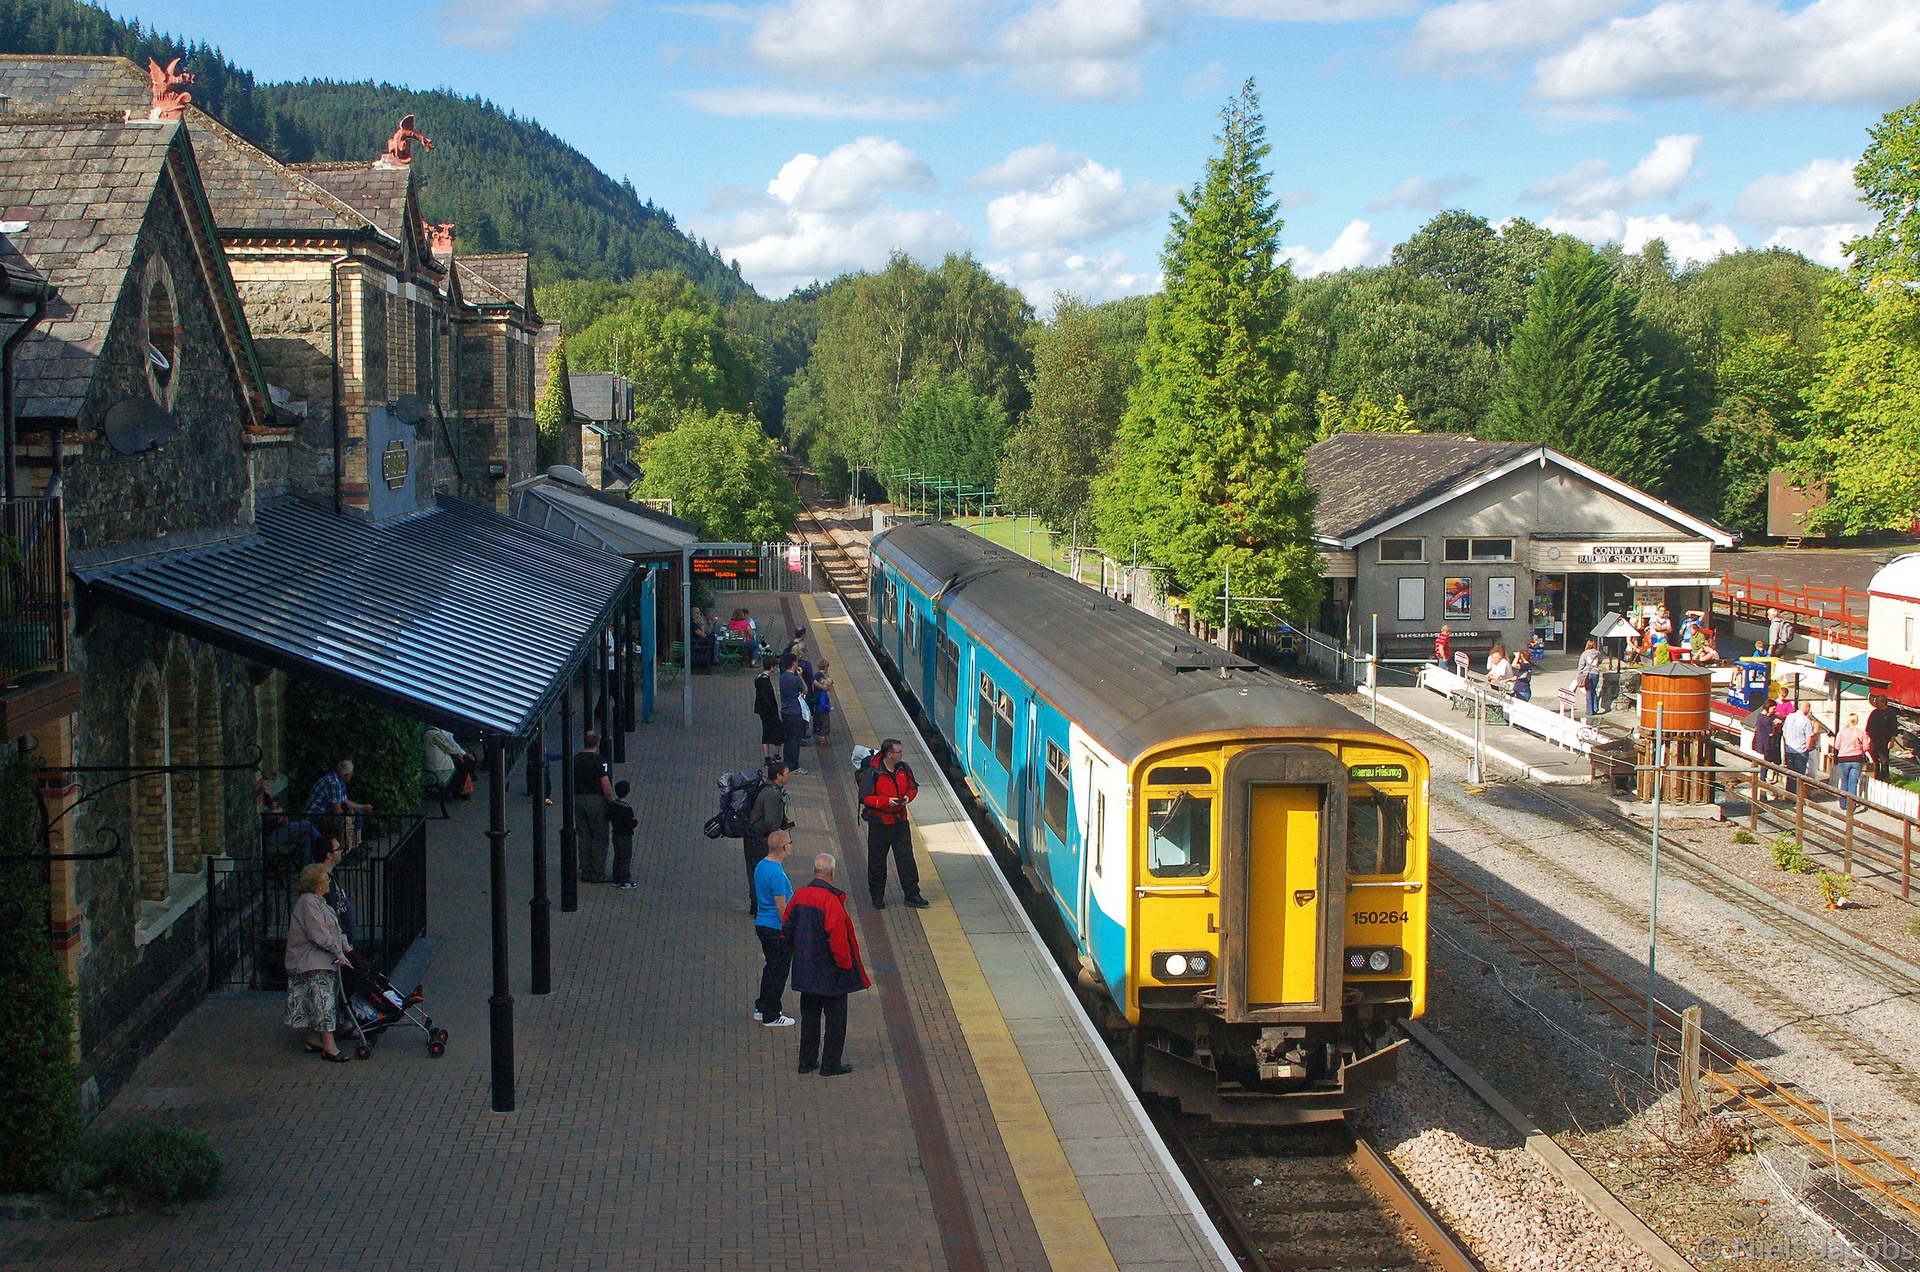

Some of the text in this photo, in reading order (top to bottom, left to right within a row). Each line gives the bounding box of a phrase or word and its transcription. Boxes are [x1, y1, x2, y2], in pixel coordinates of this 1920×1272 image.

[1594, 547, 1664, 555] CONWY VALLEY
[1579, 555, 1611, 563] RAILWAY
[1613, 555, 1635, 563] SHOP
[1643, 555, 1678, 563] MUSEUM
[602, 762, 608, 772] 7
[1352, 910, 1409, 925] 150264
